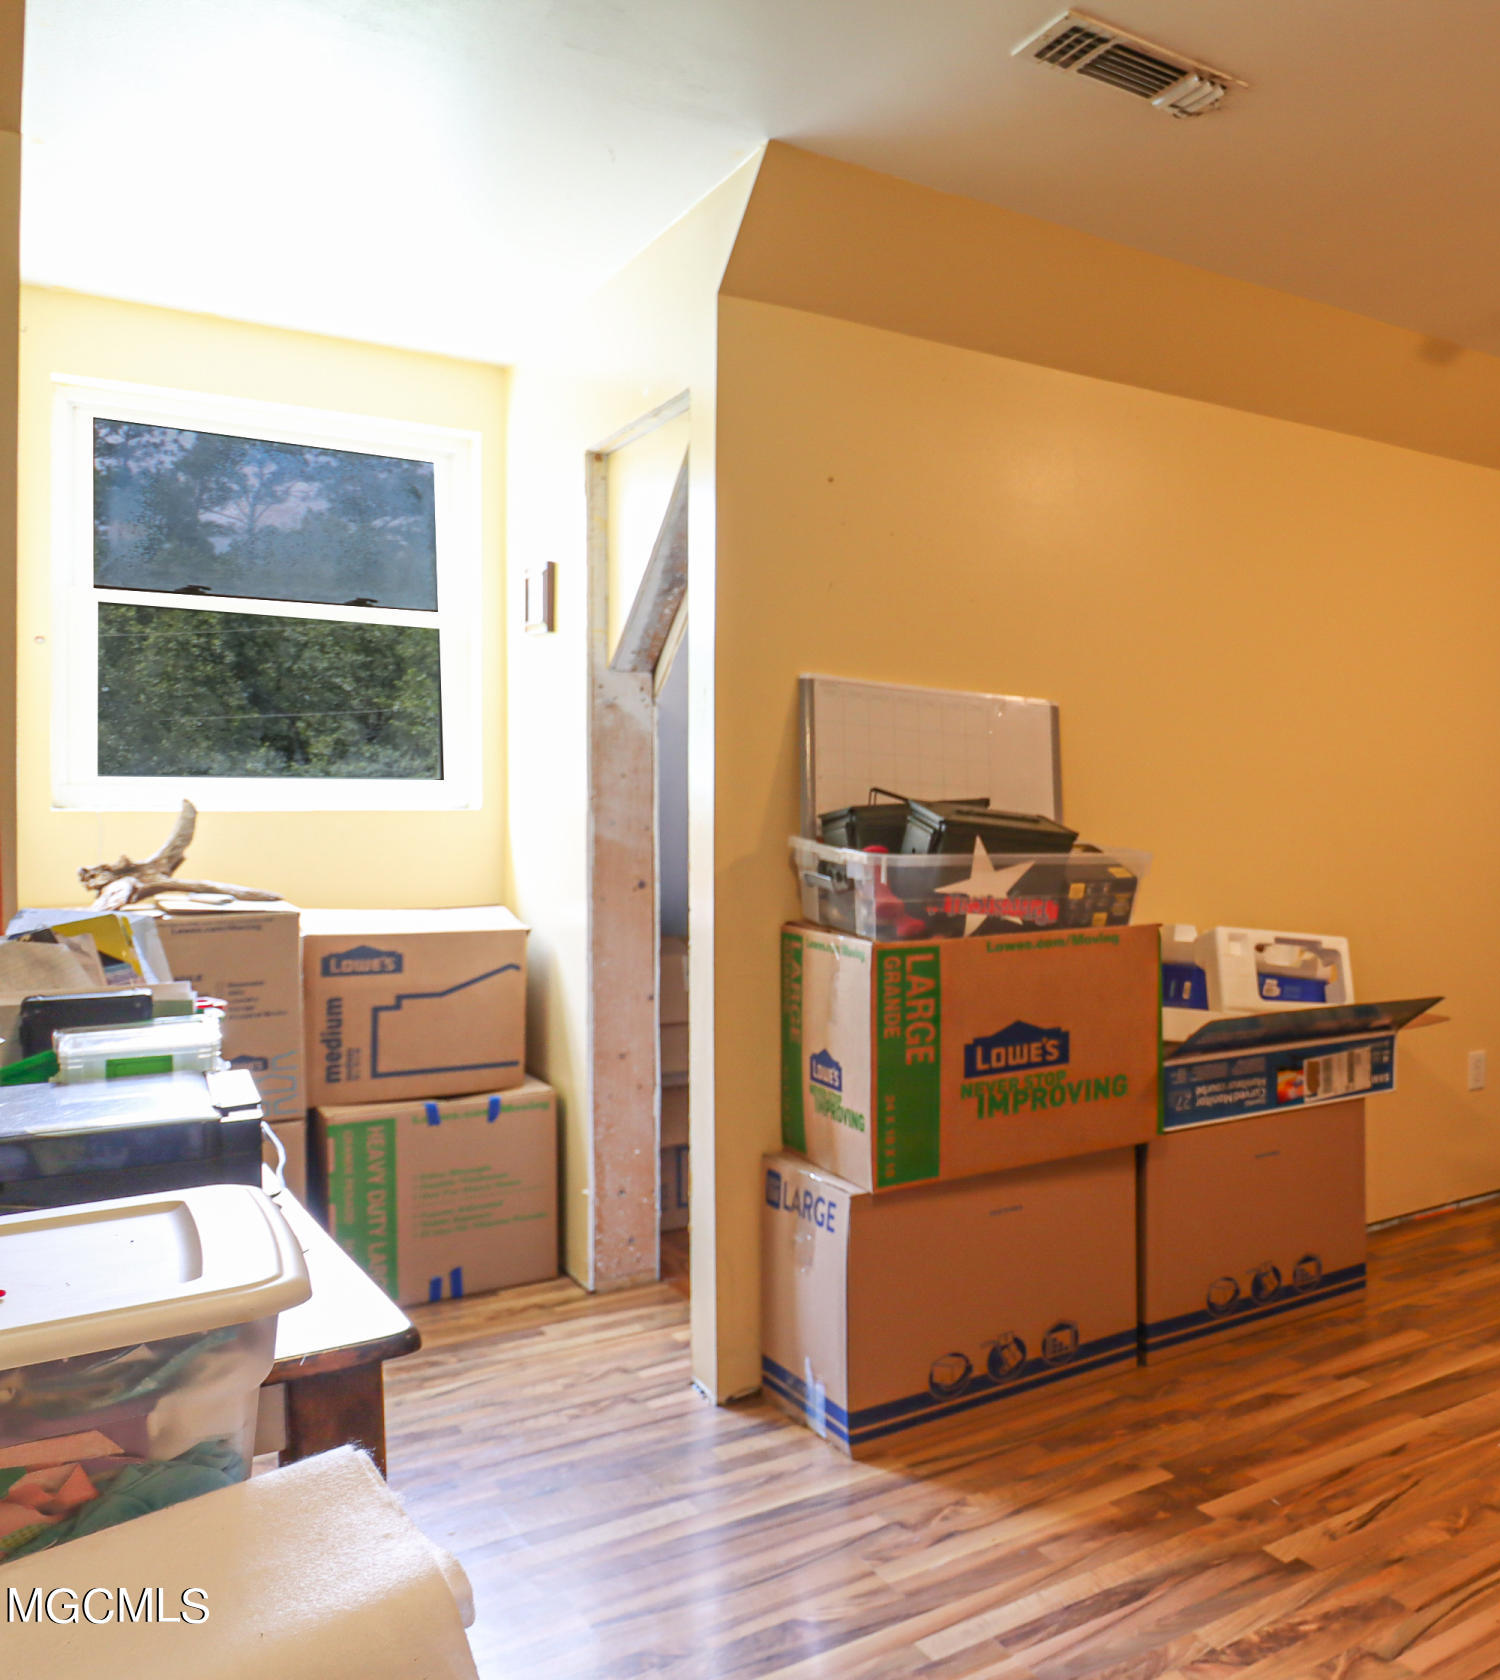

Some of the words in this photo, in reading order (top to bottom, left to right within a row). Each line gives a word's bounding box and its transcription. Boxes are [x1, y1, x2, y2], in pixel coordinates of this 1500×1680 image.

[883, 956, 900, 1040] GRANDE
[905, 954, 935, 1066] LARGE
[320, 997, 344, 1084] medium
[975, 1036, 1060, 1071] LOWE'S
[961, 1076, 1019, 1100] NEVER
[1023, 1069, 1067, 1090] STOP
[977, 1073, 1128, 1120] IMPROVING
[366, 1125, 388, 1184] HEAVY
[366, 1190, 388, 1237] DUTY
[783, 1181, 837, 1234] LARGE
